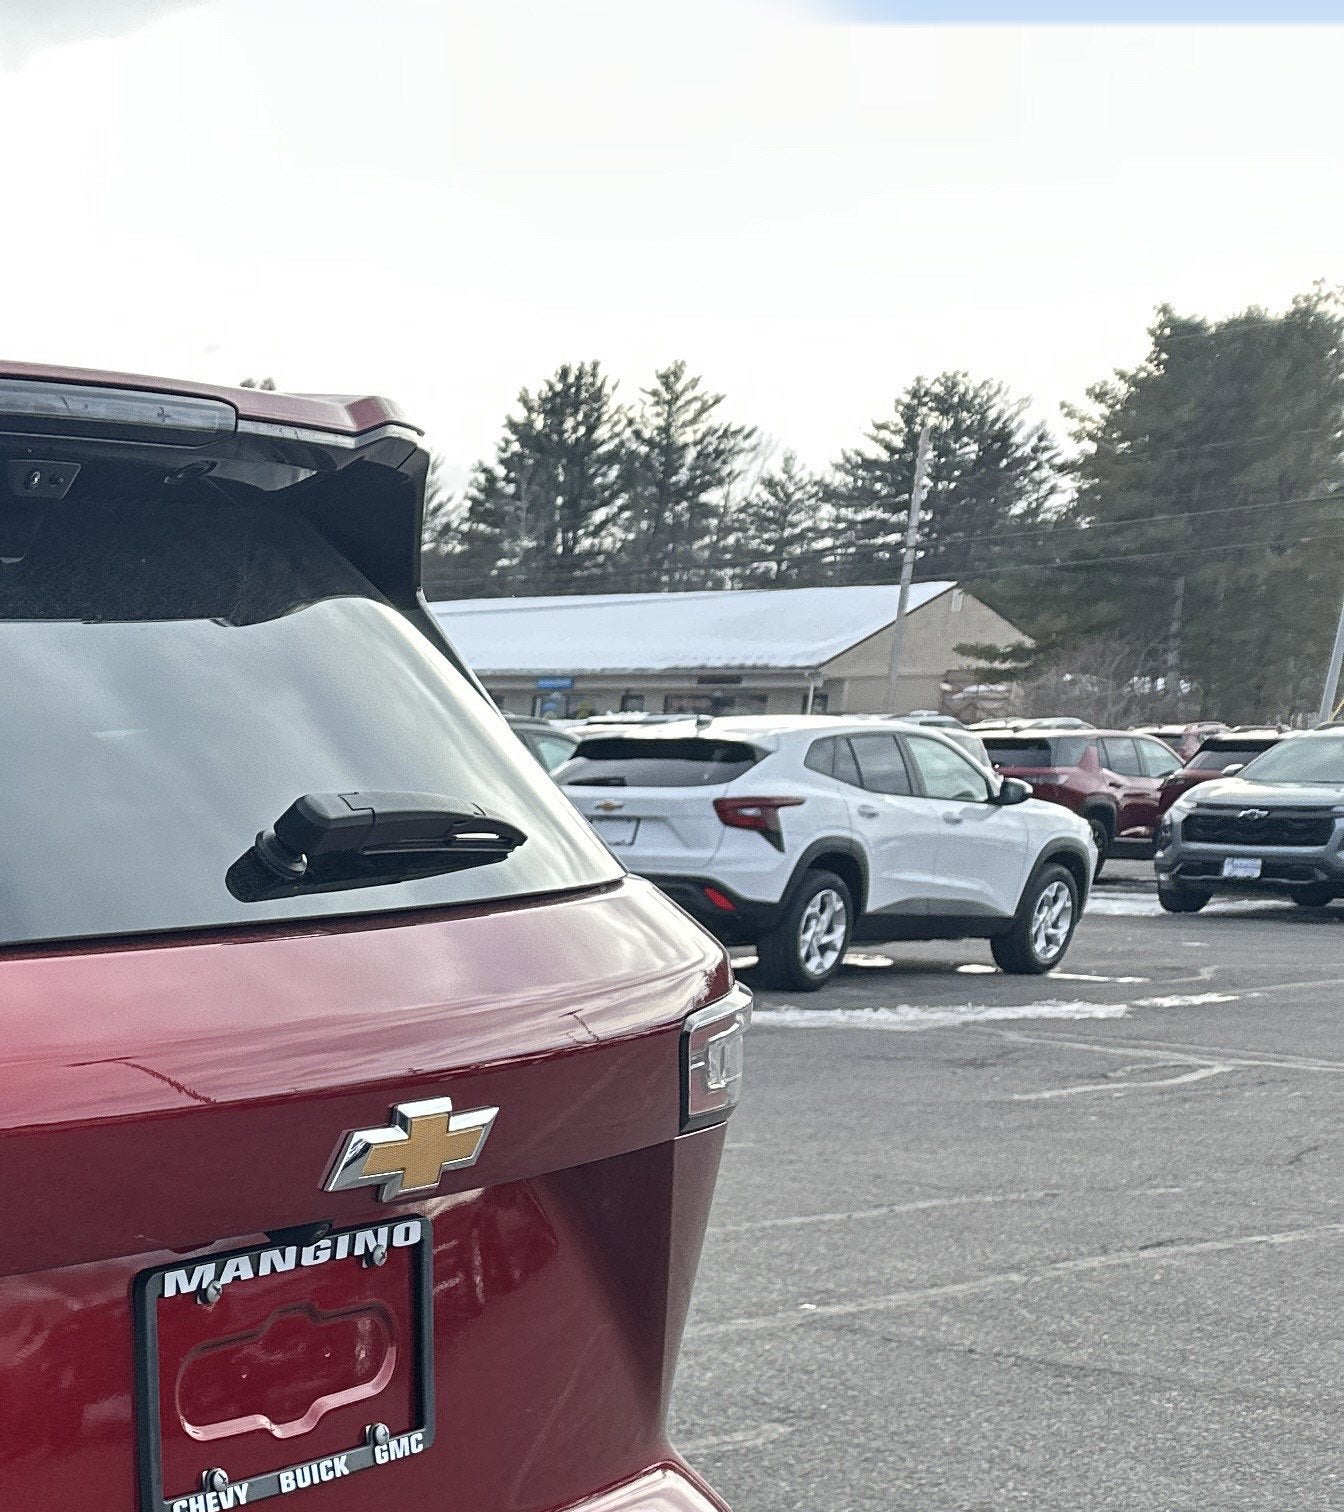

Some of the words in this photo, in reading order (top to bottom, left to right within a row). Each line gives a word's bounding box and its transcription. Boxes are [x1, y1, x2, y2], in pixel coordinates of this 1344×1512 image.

[164, 1221, 422, 1298] MANGINO
[279, 1455, 350, 1493] BUICK
[374, 1433, 424, 1465] GMC
